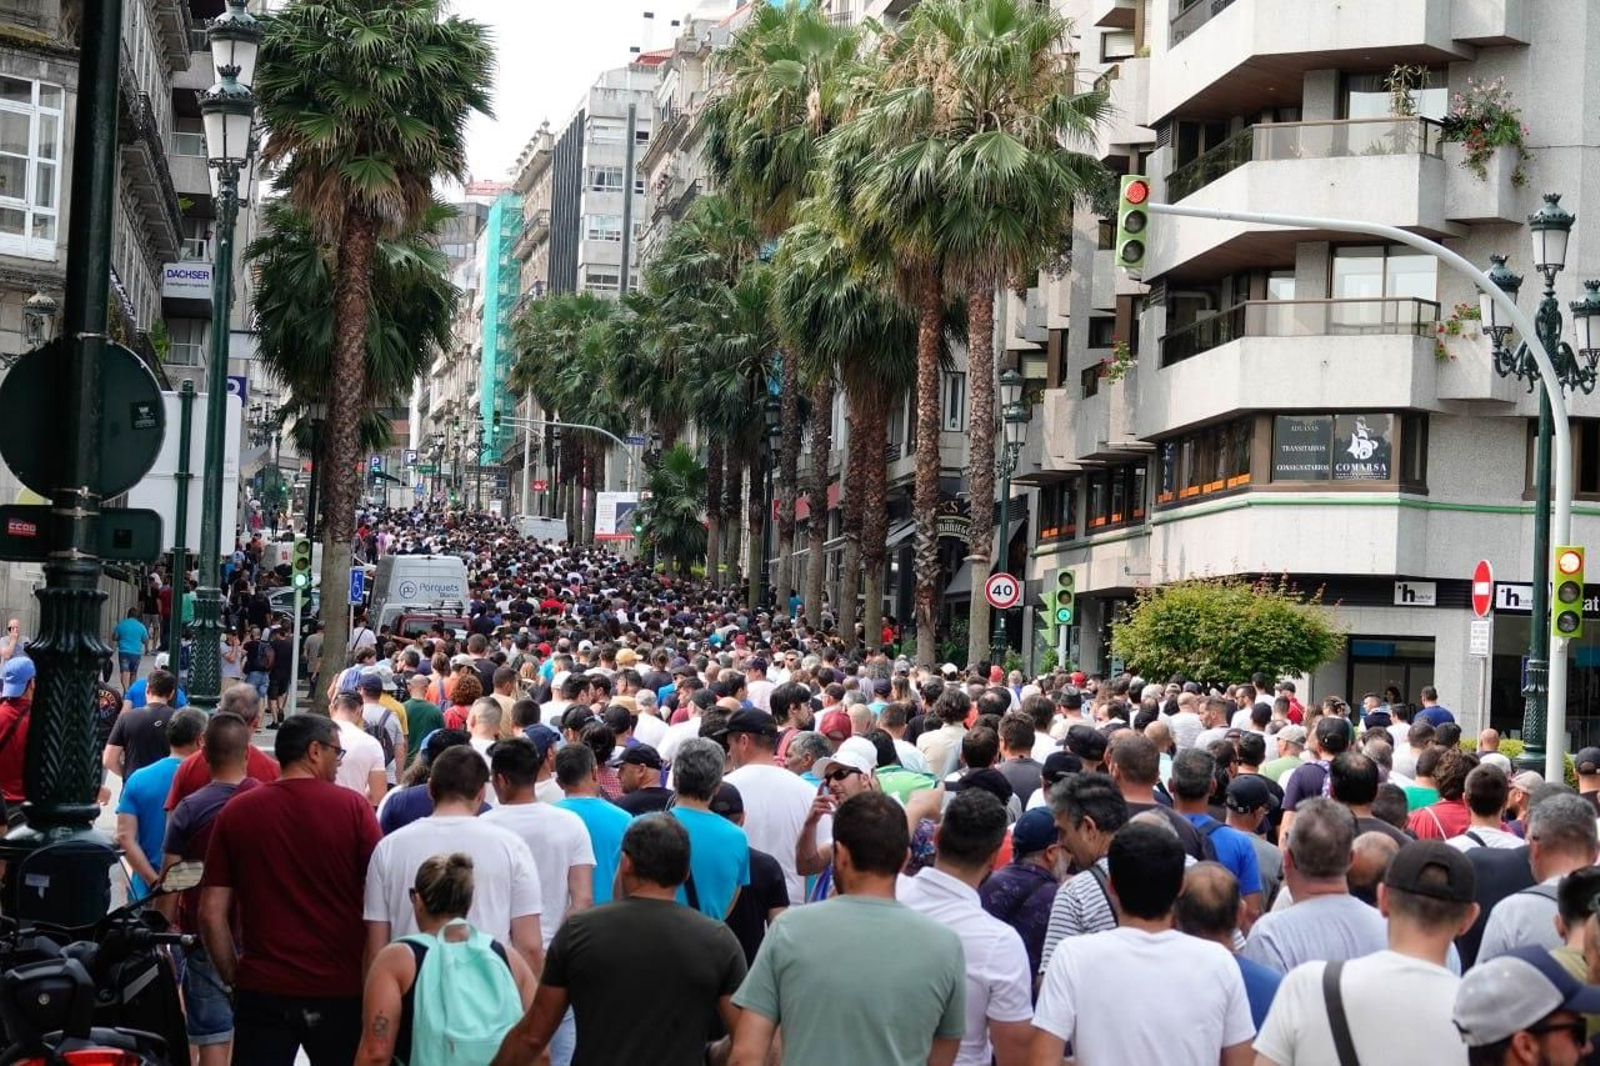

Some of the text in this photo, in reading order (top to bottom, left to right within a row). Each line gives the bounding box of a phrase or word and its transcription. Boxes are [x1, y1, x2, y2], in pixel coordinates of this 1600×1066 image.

[166, 269, 210, 280] DACHSER
[1335, 463, 1387, 472] COMARSA
[420, 583, 459, 593] Parquets
[992, 584, 1013, 597] 40
